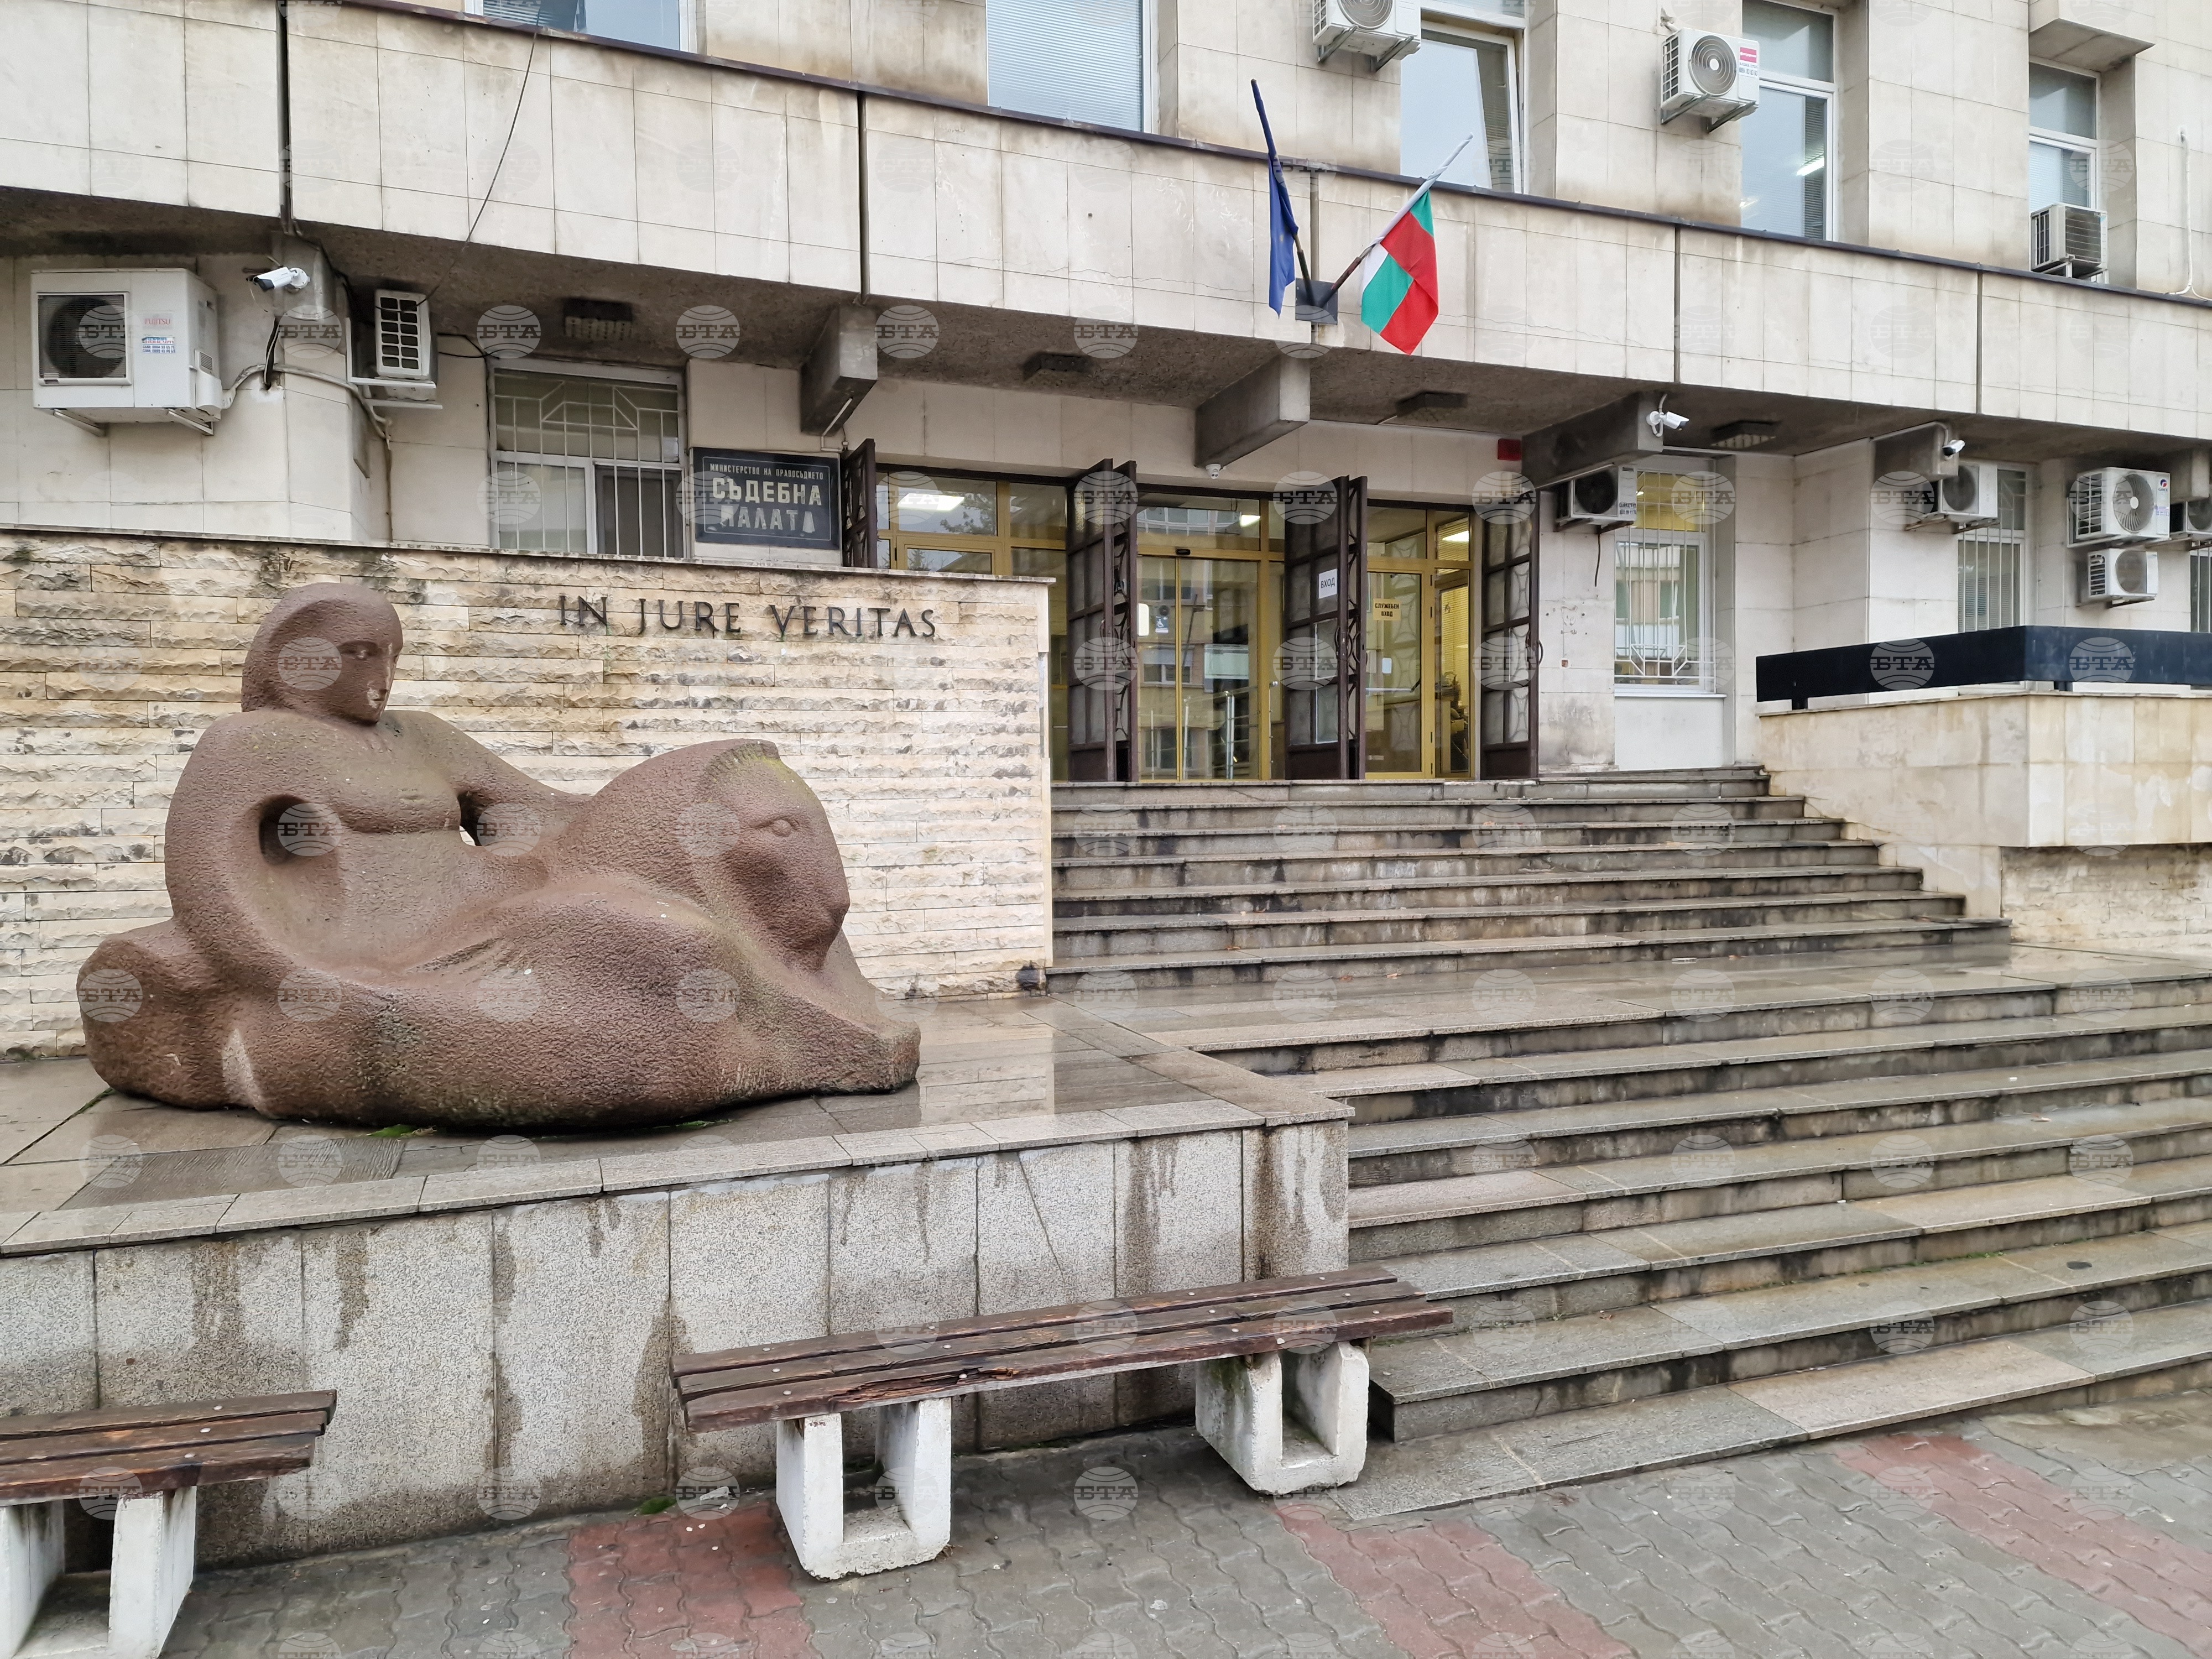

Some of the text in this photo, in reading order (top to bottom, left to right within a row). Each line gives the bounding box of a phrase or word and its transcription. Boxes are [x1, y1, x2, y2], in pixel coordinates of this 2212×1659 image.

[709, 463, 823, 480] МИНИСТЕРСТВО НА ПРАВОСЪДИЕТО
[712, 477, 822, 506] СЪДЕБНА
[1321, 577, 1335, 589] ВХОД
[559, 595, 936, 637] IN JURE VERITAS
